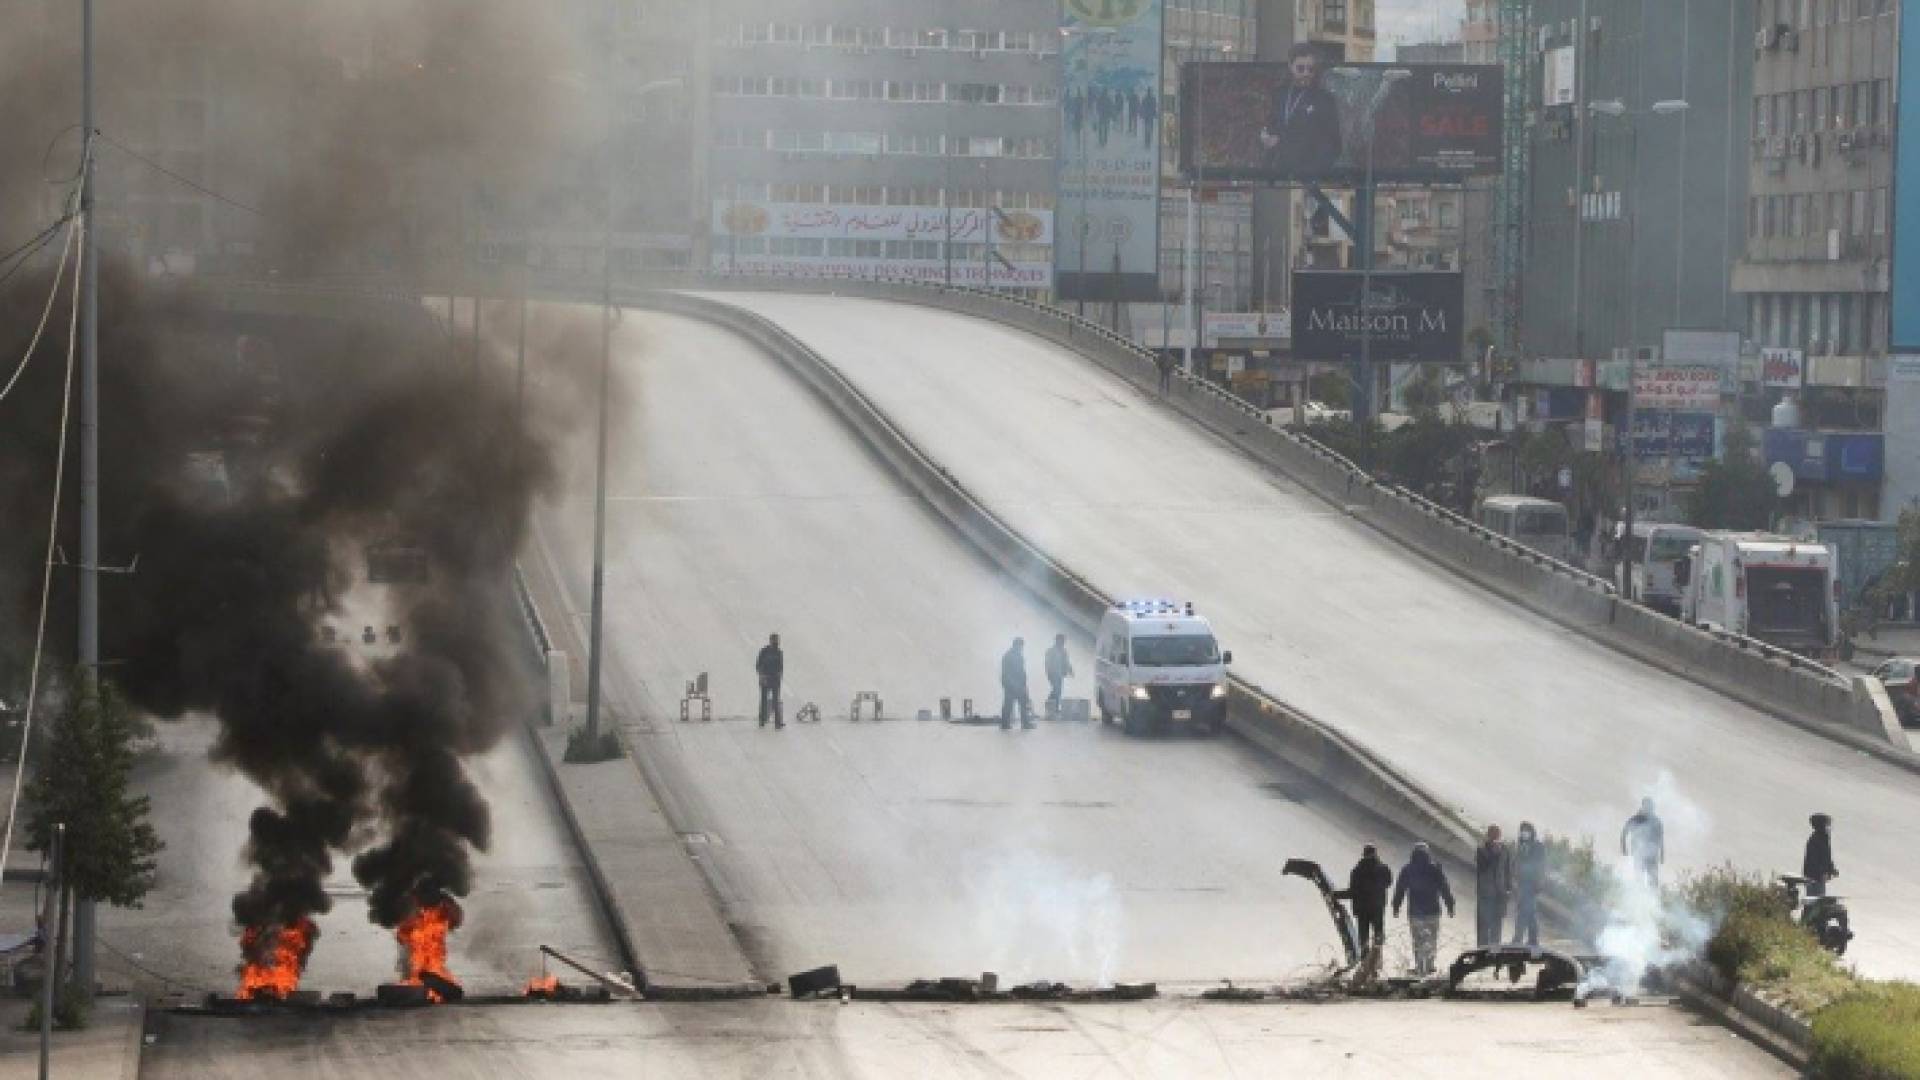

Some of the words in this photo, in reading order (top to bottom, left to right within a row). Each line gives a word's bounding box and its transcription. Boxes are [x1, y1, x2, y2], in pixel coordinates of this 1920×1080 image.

[1419, 115, 1489, 136] SALE
[1305, 305, 1408, 332] Maison
[1418, 307, 1447, 333] M
